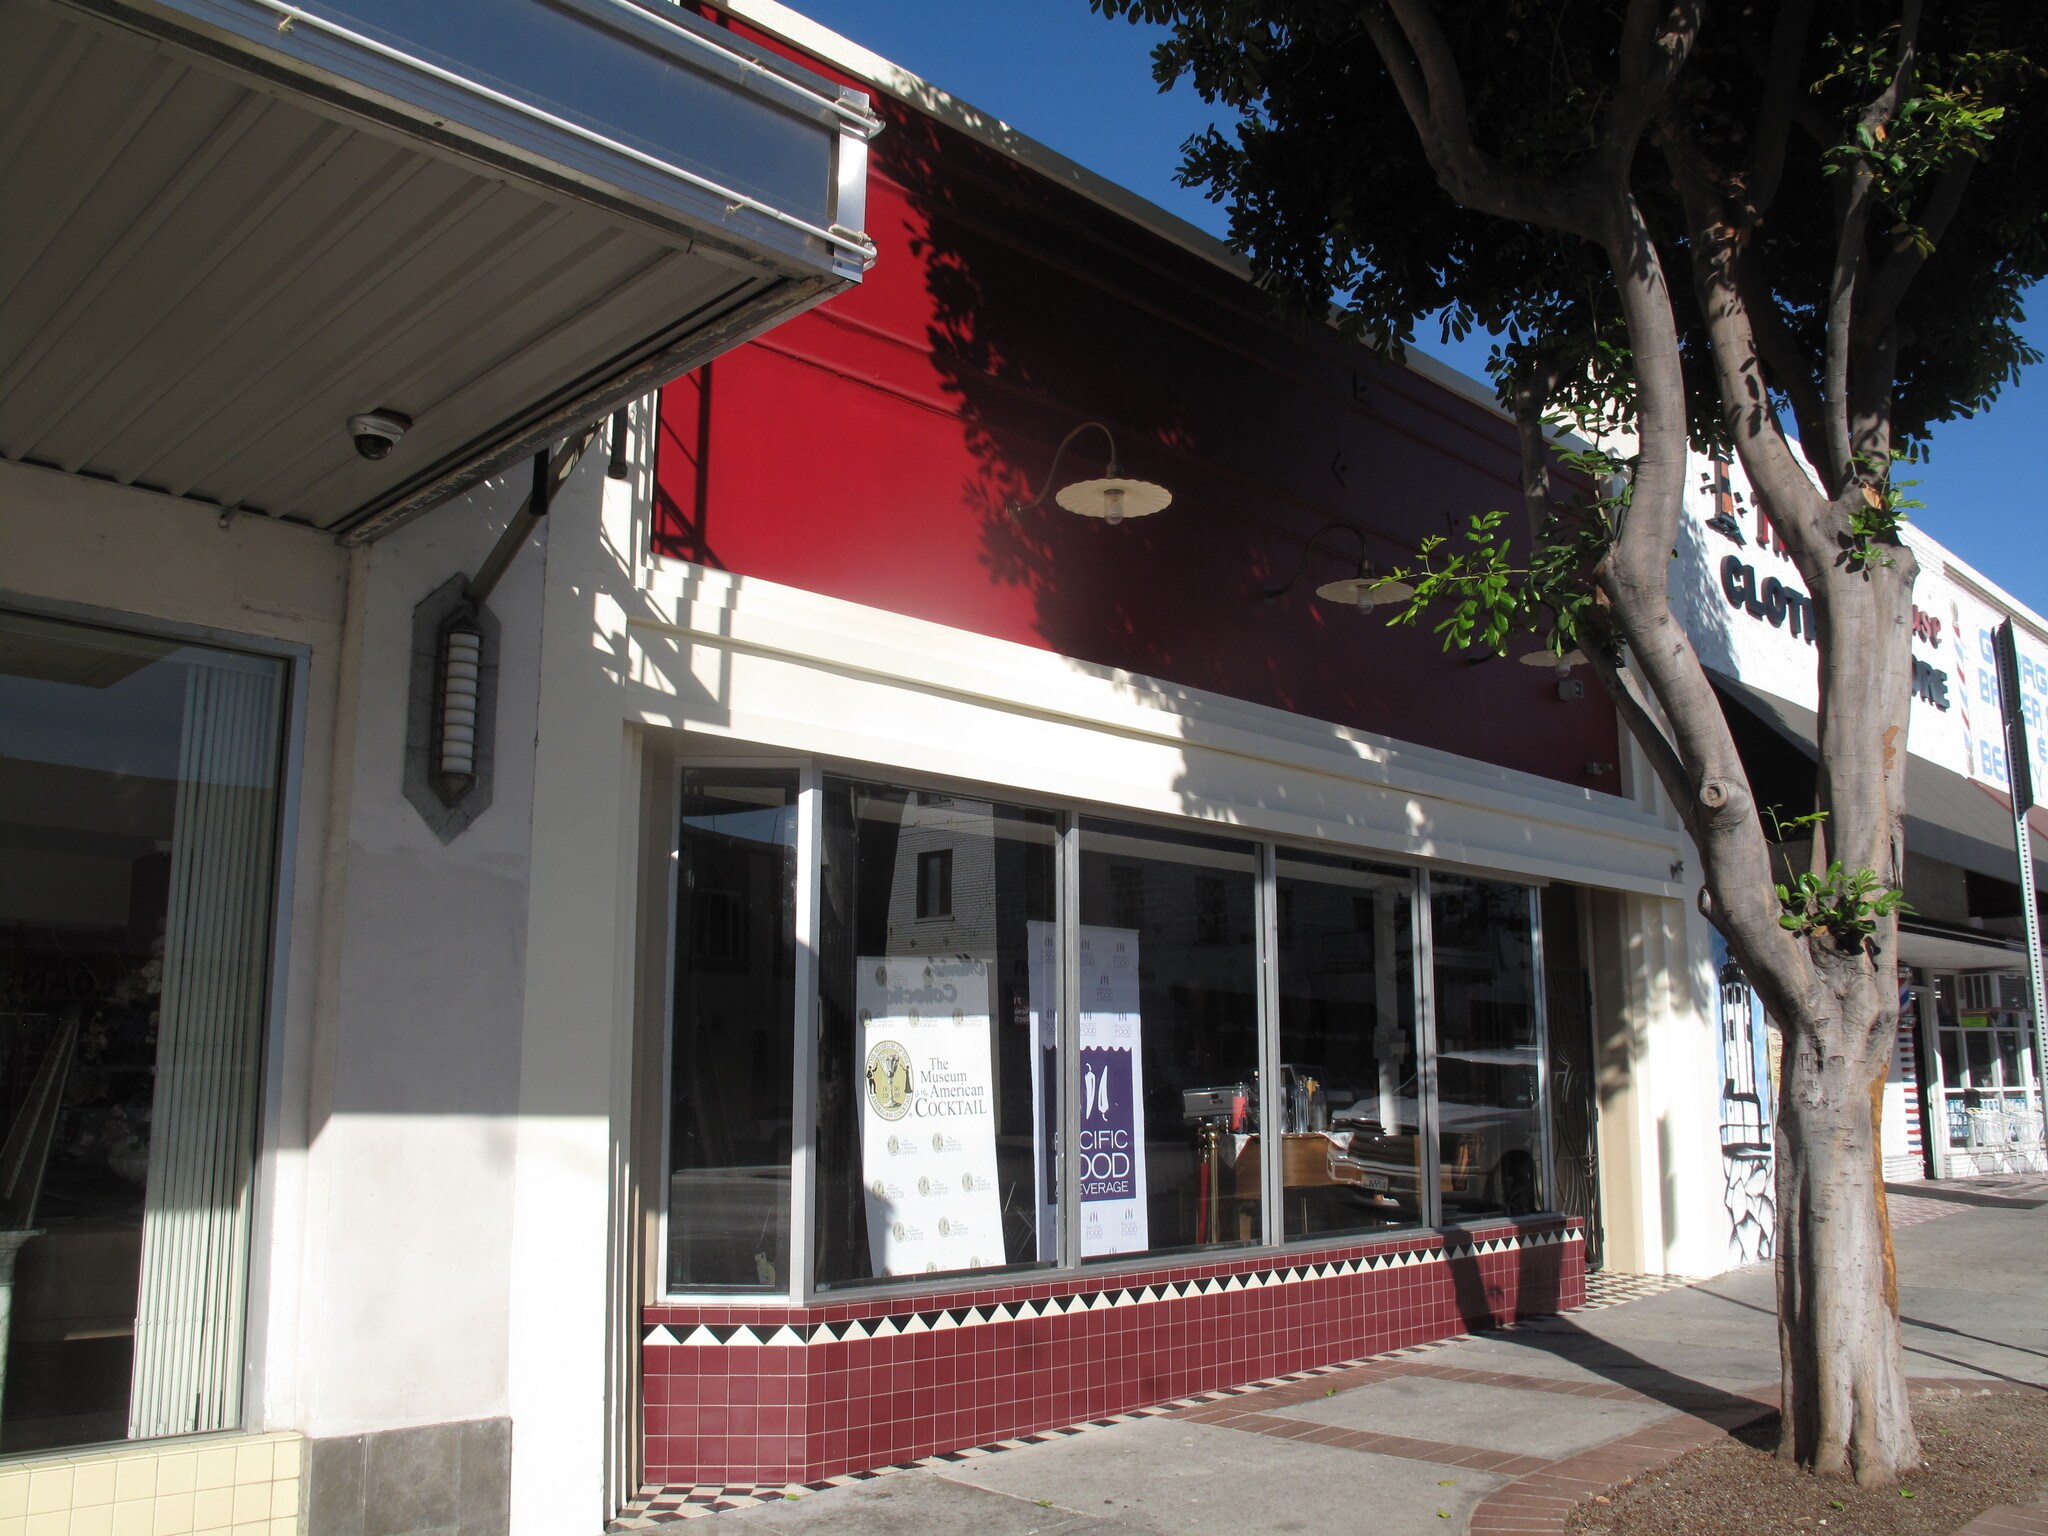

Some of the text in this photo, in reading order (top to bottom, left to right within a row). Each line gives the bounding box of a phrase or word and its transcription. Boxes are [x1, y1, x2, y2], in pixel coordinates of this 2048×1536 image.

[929, 1057, 949, 1070] The
[920, 1070, 968, 1083] Museum
[930, 1083, 985, 1099] American
